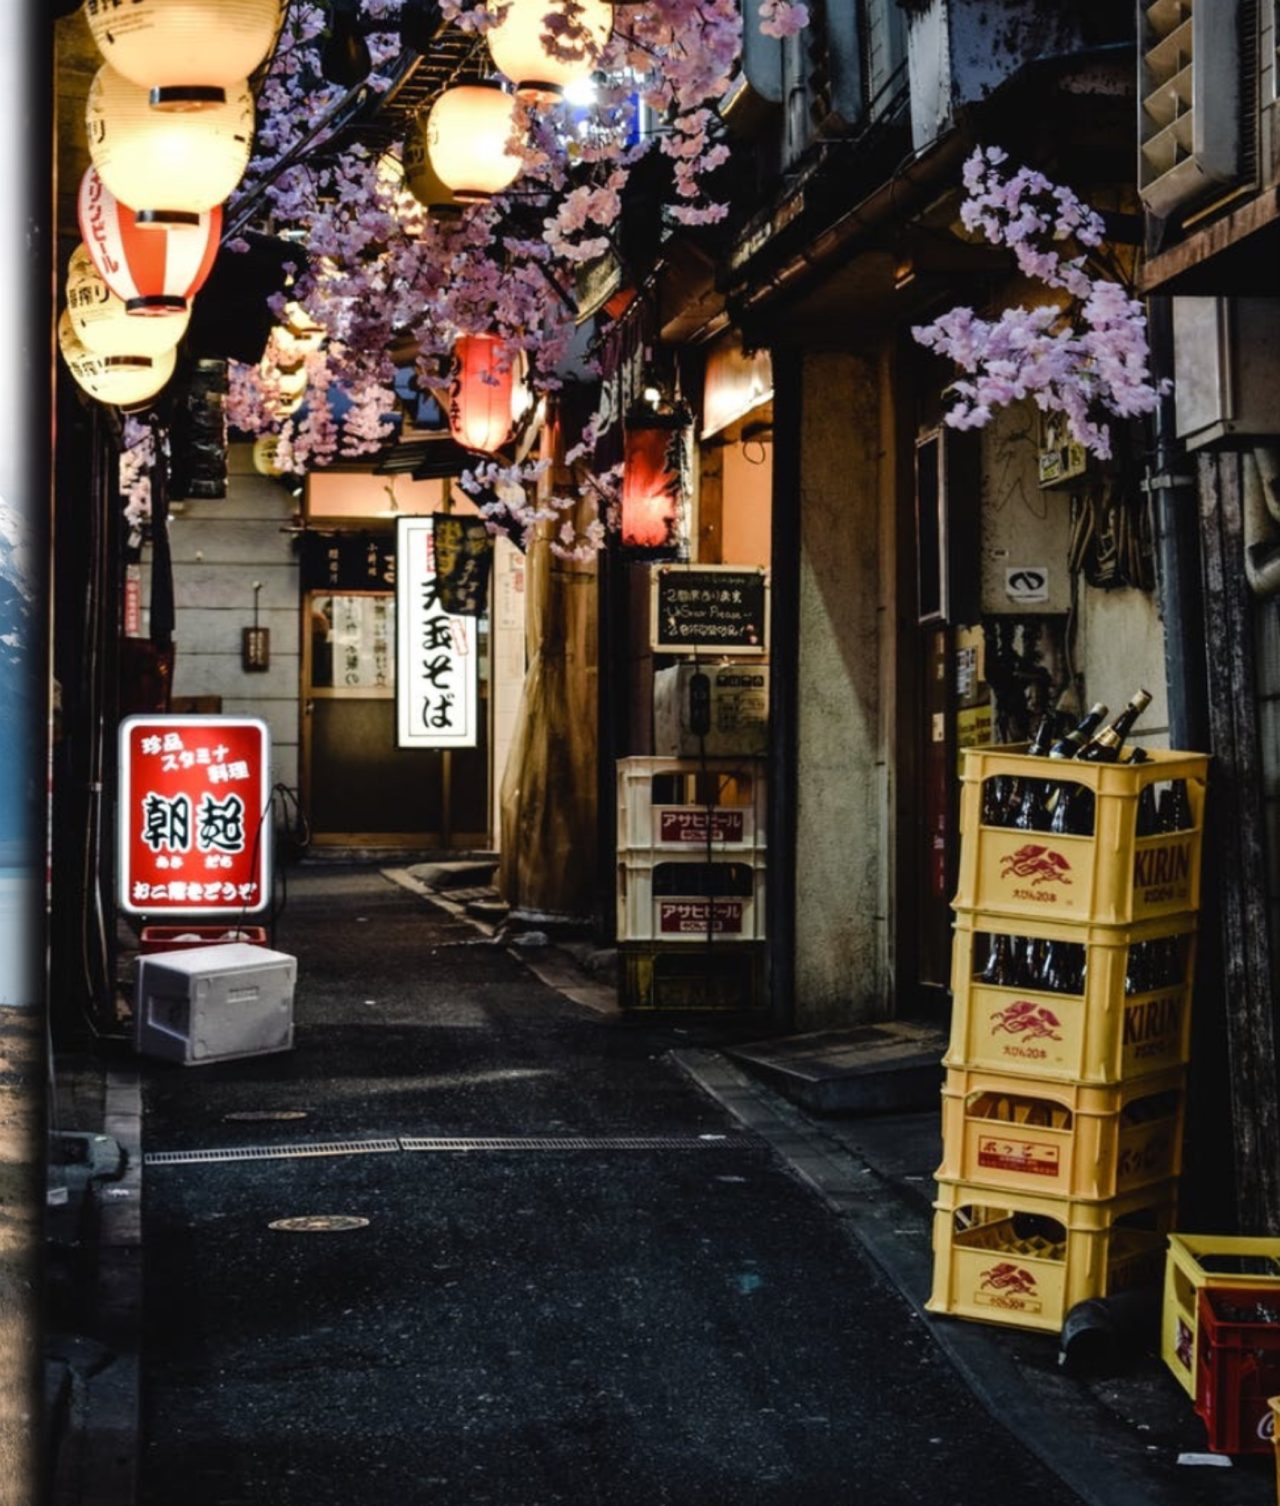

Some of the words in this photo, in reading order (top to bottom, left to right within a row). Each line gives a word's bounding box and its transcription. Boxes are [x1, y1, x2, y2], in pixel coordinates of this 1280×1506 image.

[141, 732, 184, 755] 珍品
[161, 744, 229, 772] スタミナ
[207, 761, 251, 783] 料理
[141, 791, 245, 853] 朝起
[1133, 842, 1191, 889] KIRIN
